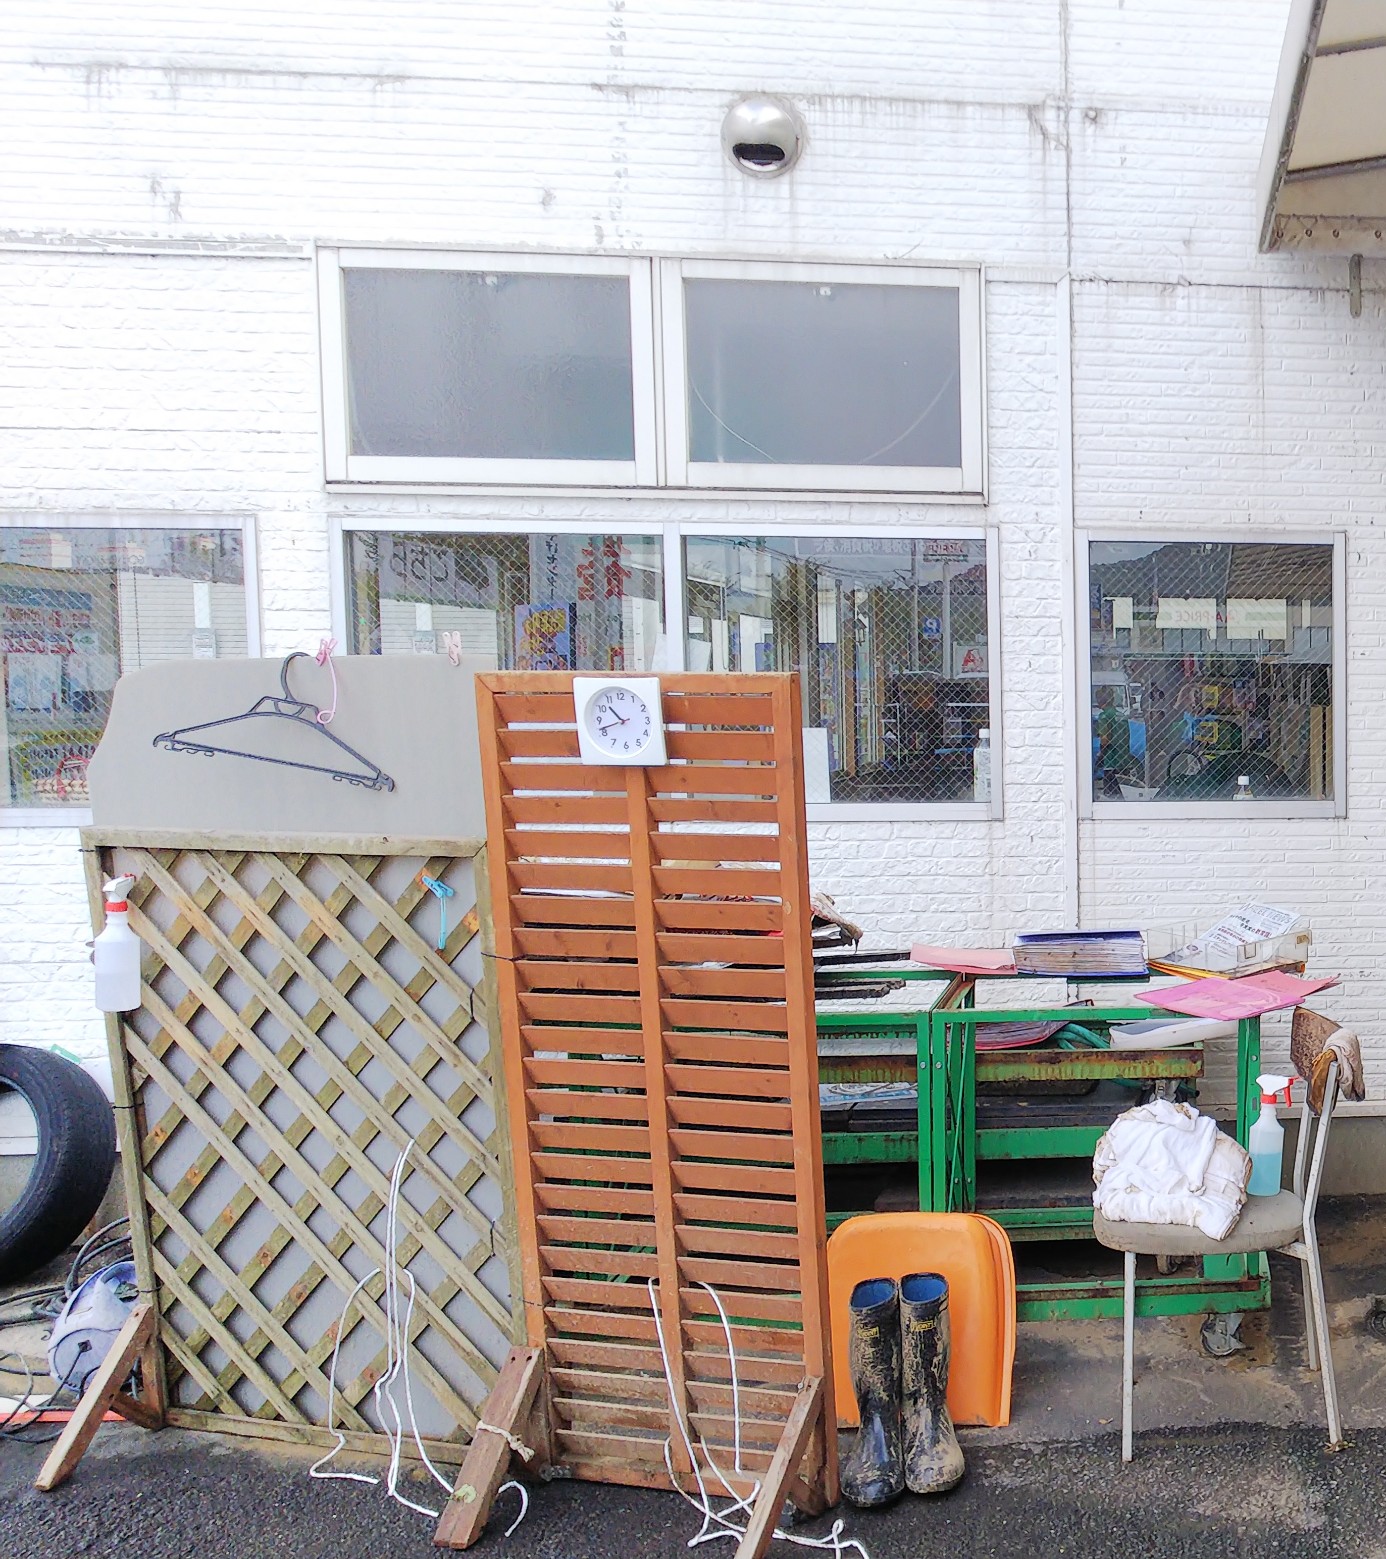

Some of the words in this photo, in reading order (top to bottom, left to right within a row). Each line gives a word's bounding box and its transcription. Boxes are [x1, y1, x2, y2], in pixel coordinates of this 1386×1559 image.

[605, 694, 613, 704] 11
[616, 692, 625, 700] 12
[631, 695, 635, 703] 1
[596, 705, 607, 713] 10
[640, 704, 646, 712] 2
[596, 716, 602, 725] 9
[645, 717, 650, 725] 3
[643, 729, 649, 737] 4
[624, 741, 629, 749] 6
